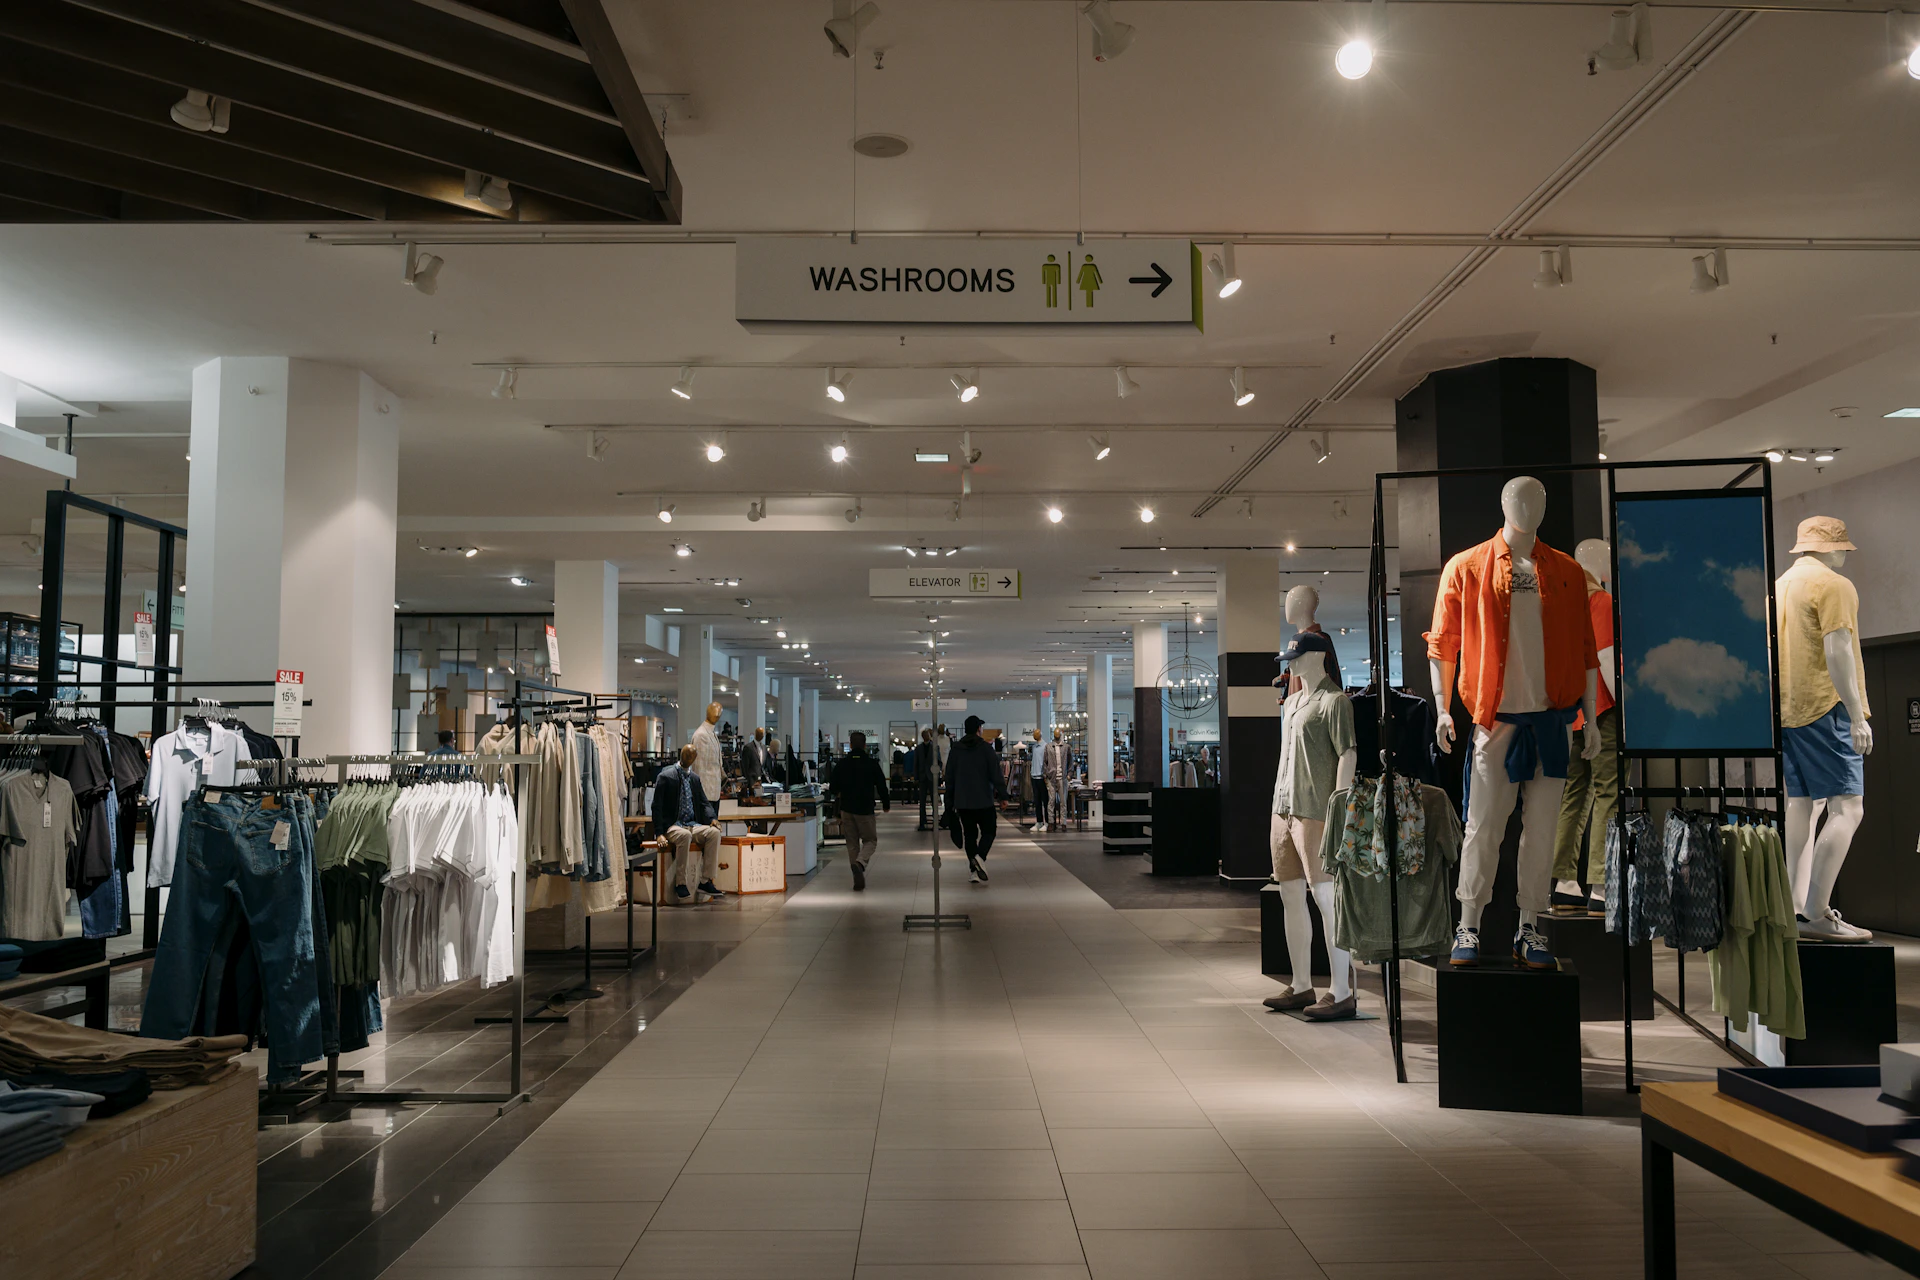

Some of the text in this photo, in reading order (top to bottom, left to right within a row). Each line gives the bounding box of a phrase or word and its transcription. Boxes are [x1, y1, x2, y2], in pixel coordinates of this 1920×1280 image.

[809, 266, 1016, 293] WASHROOMS
[909, 577, 961, 587] ELEVATOR
[172, 605, 185, 616] FITTI
[136, 613, 151, 624] SALE
[139, 630, 149, 639] 15%
[279, 671, 301, 684] SALE
[281, 691, 297, 702] 15%
